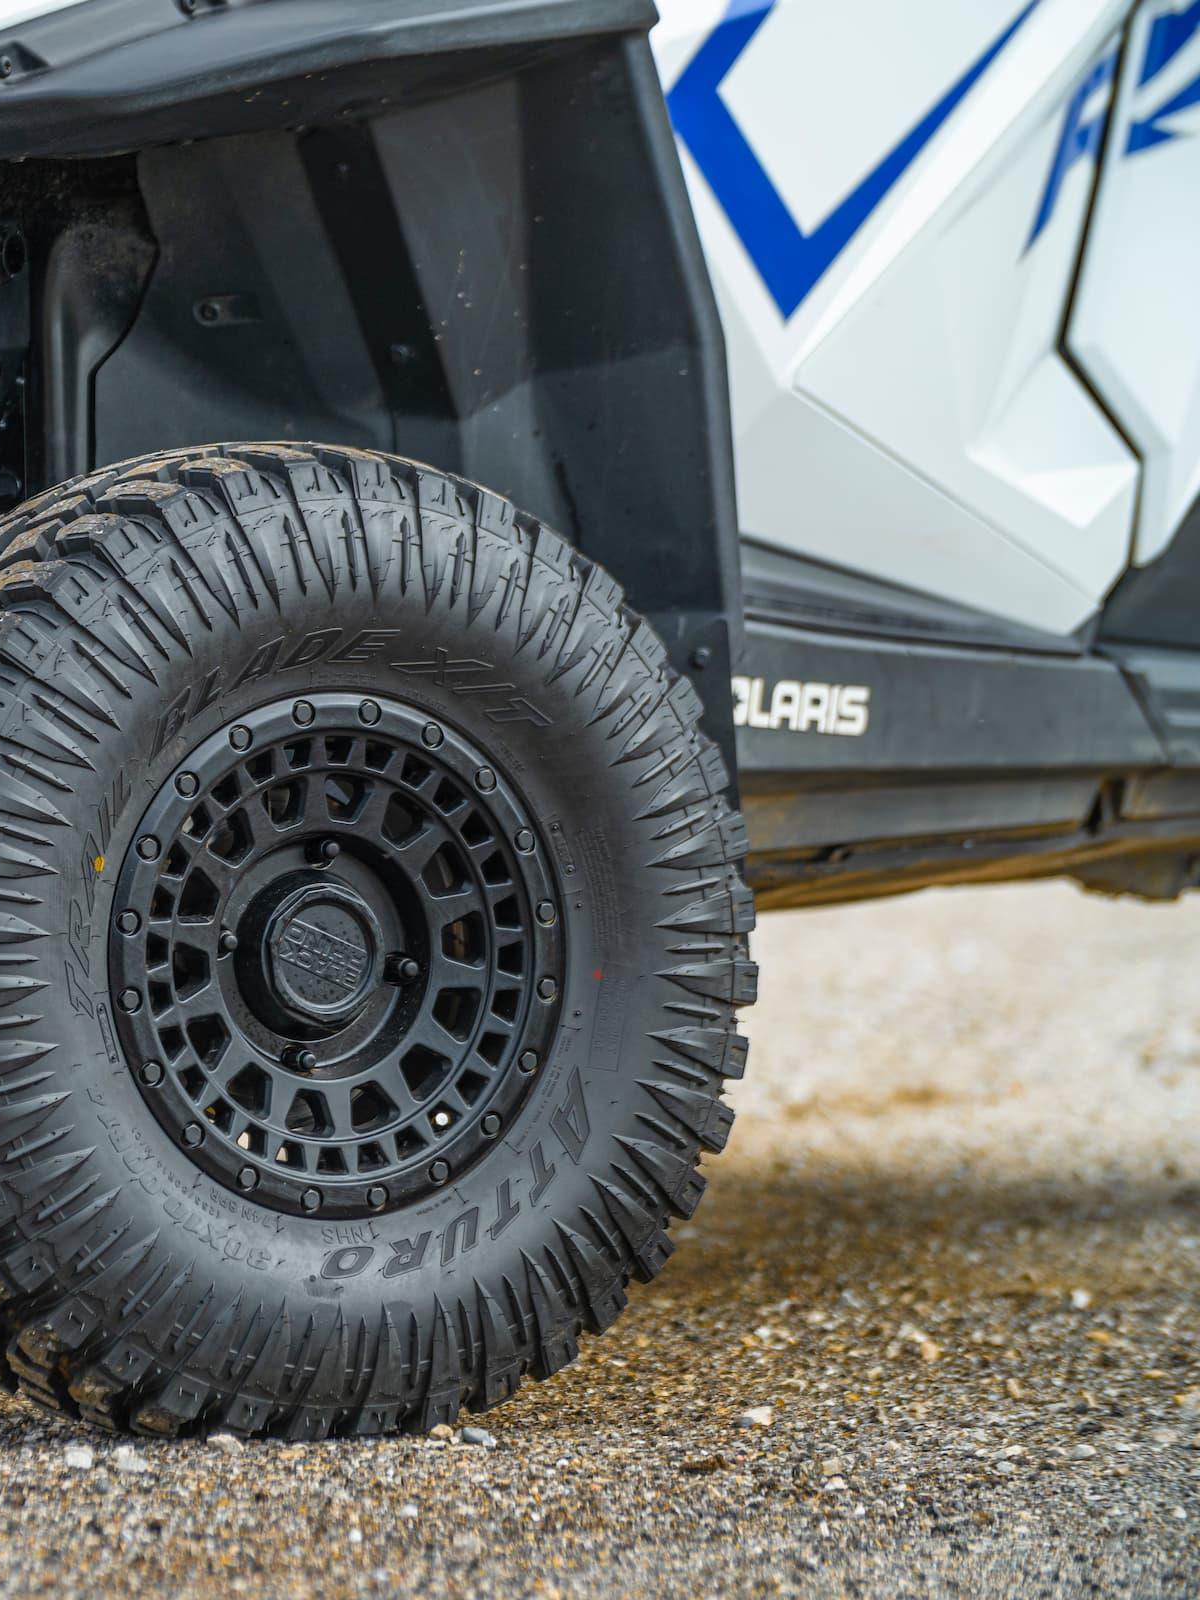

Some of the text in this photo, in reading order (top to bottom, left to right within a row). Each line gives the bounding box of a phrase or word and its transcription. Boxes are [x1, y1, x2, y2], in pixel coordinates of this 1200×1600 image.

[731, 675, 871, 736] OLARIS
[65, 769, 132, 1020] TRAIL
[149, 628, 400, 766] BLADE
[279, 940, 359, 990] BLACK
[284, 924, 366, 974] RHINO
[320, 1065, 591, 1280] ATTURO
